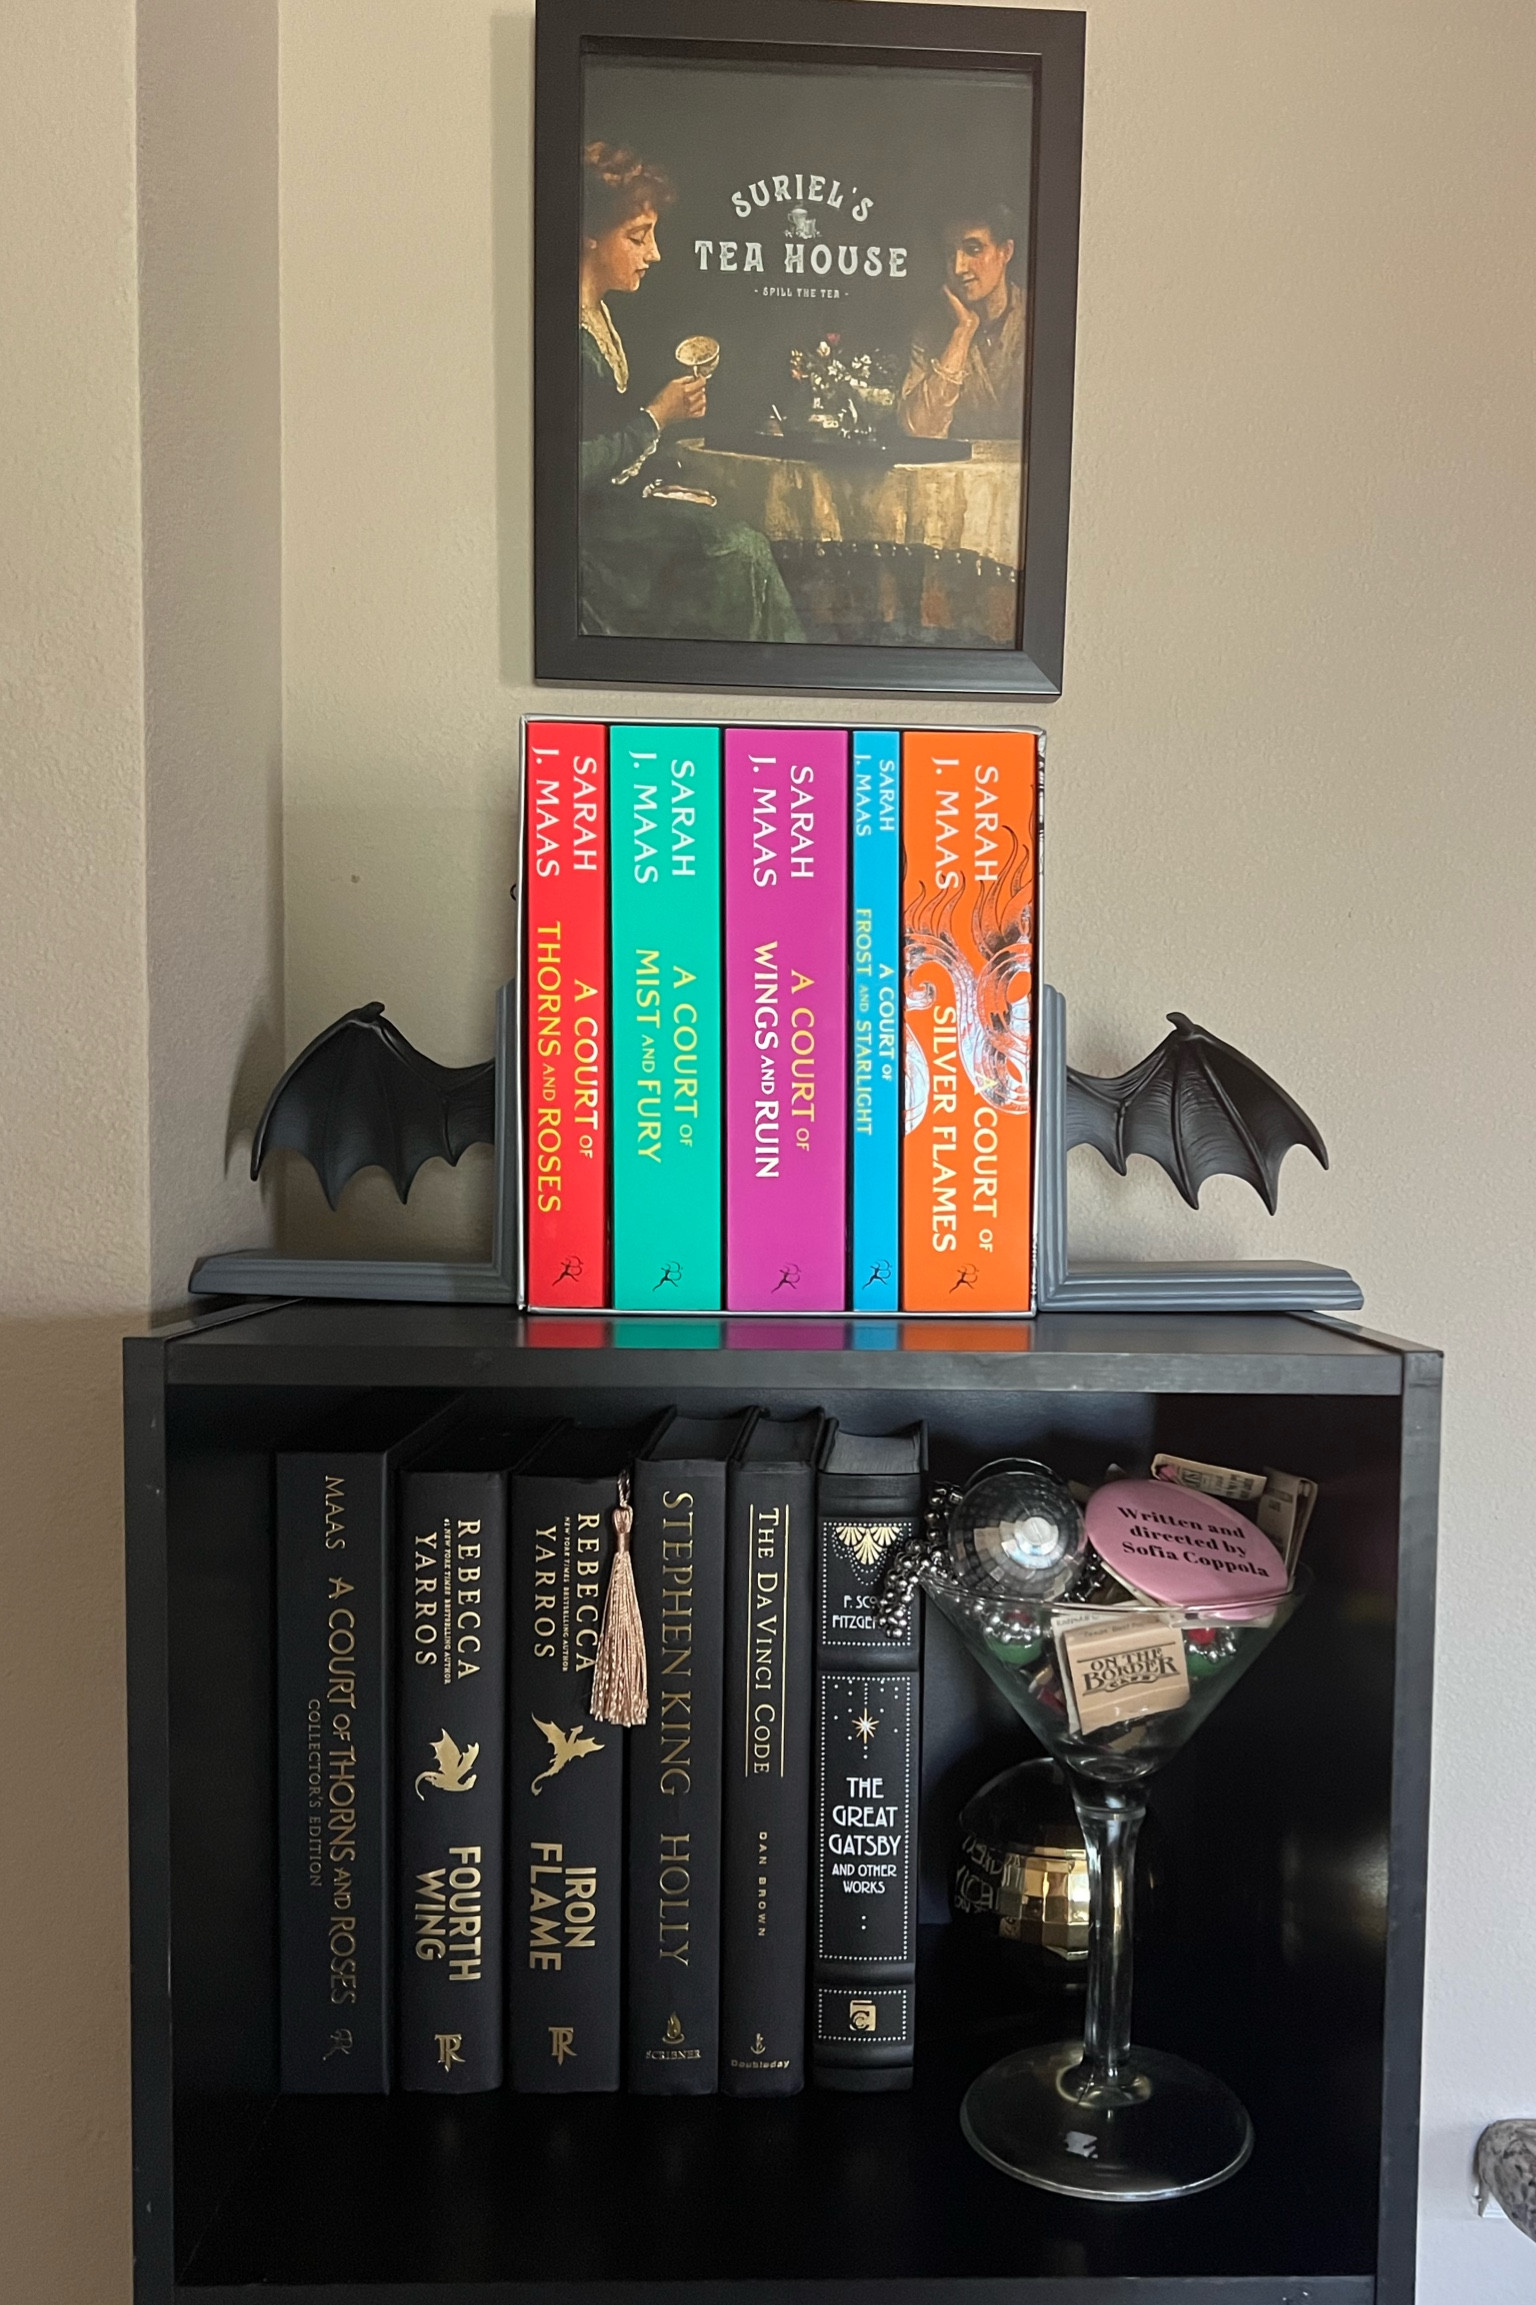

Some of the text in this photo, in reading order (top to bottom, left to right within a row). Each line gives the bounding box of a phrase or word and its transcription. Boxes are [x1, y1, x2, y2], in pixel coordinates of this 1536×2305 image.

[731, 174, 874, 222] SURIEL'S
[694, 240, 908, 278] TEA HOUSE
[762, 286, 840, 299] SPILL THE TEA
[531, 746, 560, 878] J. MAAS
[572, 755, 598, 872] SARAH
[628, 750, 659, 885] J. MAAS
[671, 759, 697, 878] SARAH
[747, 754, 778, 888] J. MAAS
[789, 765, 815, 880] SARAH
[853, 753, 872, 837] J. MAAS
[879, 760, 896, 832] SARAH
[931, 757, 960, 891] J. MAAS
[974, 764, 999, 882] SARAH
[635, 948, 662, 1164] MIST AND FURY
[672, 965, 698, 1148] A COURT OF
[753, 940, 780, 1179] WINGS AND RUIN
[790, 969, 815, 1152] A COURT OF
[855, 908, 872, 1136] FROST AND STARLIGHT
[878, 963, 896, 1082] A COURT OF
[536, 921, 562, 1213] THORNS AND ROSES
[573, 979, 599, 1159] A COURT OF
[931, 1005, 957, 1253] SILVER FLAMES
[973, 1073, 999, 1253] A COURT OF
[443, 1528, 451, 1547] NEW
[443, 1549, 451, 1569] YORK
[563, 1537, 571, 1557] YORK
[757, 1506, 780, 1560] THE
[1117, 1506, 1246, 1540] Written and
[1121, 1541, 1271, 1578] Sofia Coppola
[1128, 1525, 1249, 1558] directed by
[414, 1531, 438, 1665] YARROS
[443, 1571, 451, 1596] TIMES
[457, 1518, 481, 1680] REBECCA
[533, 1525, 557, 1659] YARROS
[562, 1586, 570, 1638] BESTSELLING
[563, 1559, 571, 1582] TIMES
[575, 1512, 600, 1673] REBECCA
[443, 1598, 451, 1650] BESTSELLING
[443, 1651, 451, 1685] AUTHOR
[561, 1640, 569, 1672] AUTHOR
[660, 1490, 695, 1798] STEPHEN KING
[754, 1611, 778, 1692] VINCI
[1090, 1647, 1164, 1671] ON THE
[1082, 1656, 1179, 1691] BORDER
[325, 1474, 357, 2005] MAAS A COURT OF THORNS AND ROSES
[752, 1704, 776, 1775] CODE
[307, 1698, 323, 1887] COLLECTOR'S EDITION
[832, 1805, 898, 1827] GREAT
[846, 1777, 884, 1798] THE
[757, 1832, 767, 1938] DAN BROWN
[828, 1834, 901, 1856] GATSBY
[832, 1863, 897, 1877] AND OTHER
[843, 1881, 886, 1894] WORKS
[414, 1867, 446, 1962] WING
[448, 1847, 482, 1981] FOURTH
[529, 1841, 563, 1972] FLAME
[563, 1866, 597, 1949] IRON
[658, 1832, 690, 1968] HOLLY
[646, 2049, 702, 2060] SCRIBNER
[731, 2058, 790, 2070] Doubleday
